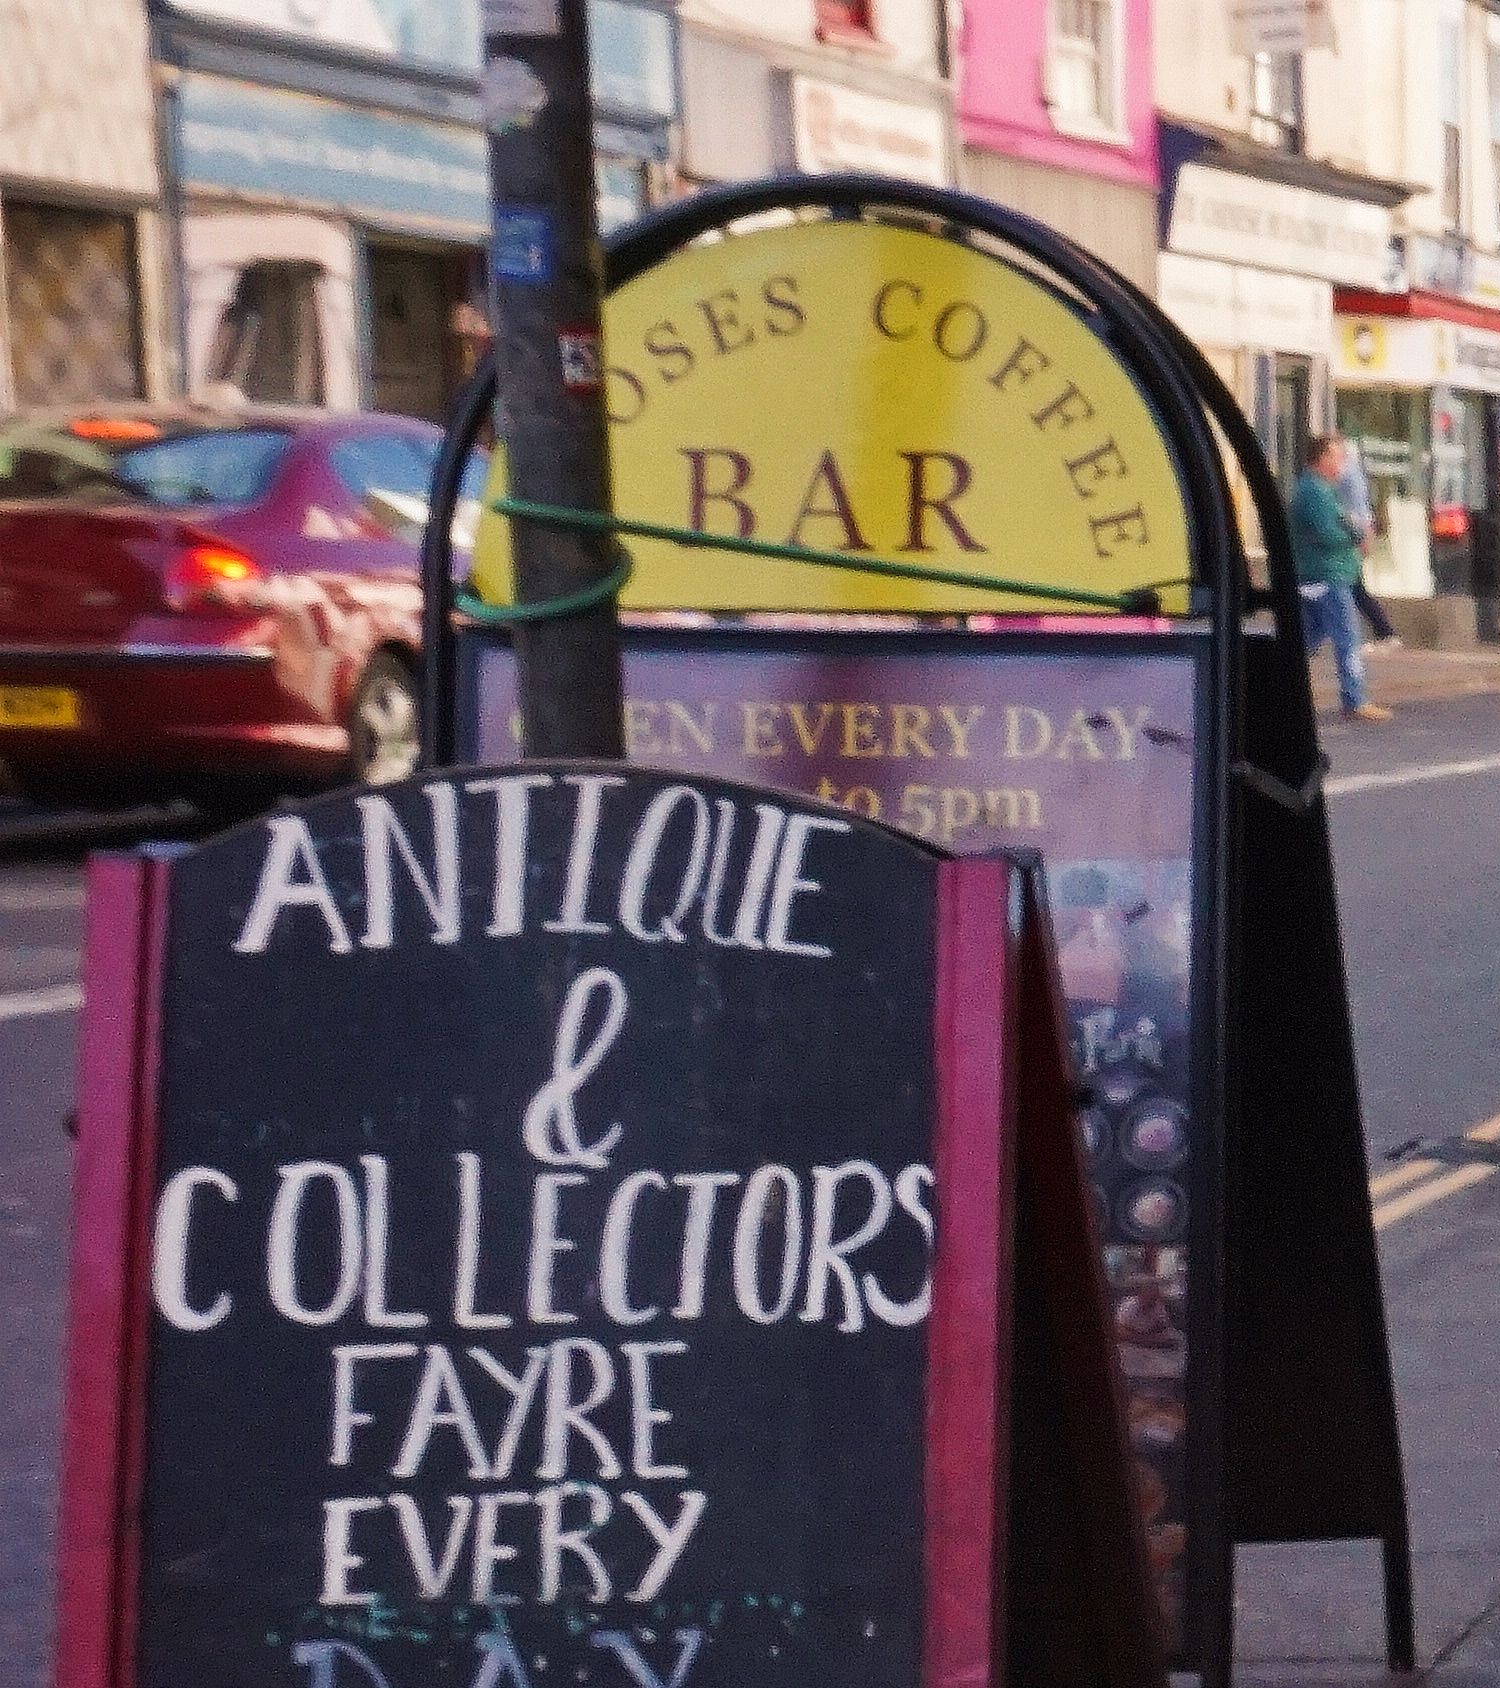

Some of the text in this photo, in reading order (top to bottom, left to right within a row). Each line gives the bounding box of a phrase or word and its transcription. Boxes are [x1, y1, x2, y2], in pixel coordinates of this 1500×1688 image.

[605, 274, 1151, 560] OSES COFFEE
[678, 448, 987, 555] BAR
[740, 701, 986, 759] EVERY
[1004, 703, 1152, 761] DAY
[230, 773, 853, 960] ANTIQUE
[900, 783, 1043, 845] 5pm
[520, 966, 630, 1169] &
[152, 1151, 936, 1334] COLLECTORS
[329, 1336, 693, 1480] FAYRE
[317, 1482, 709, 1608] EVERY
